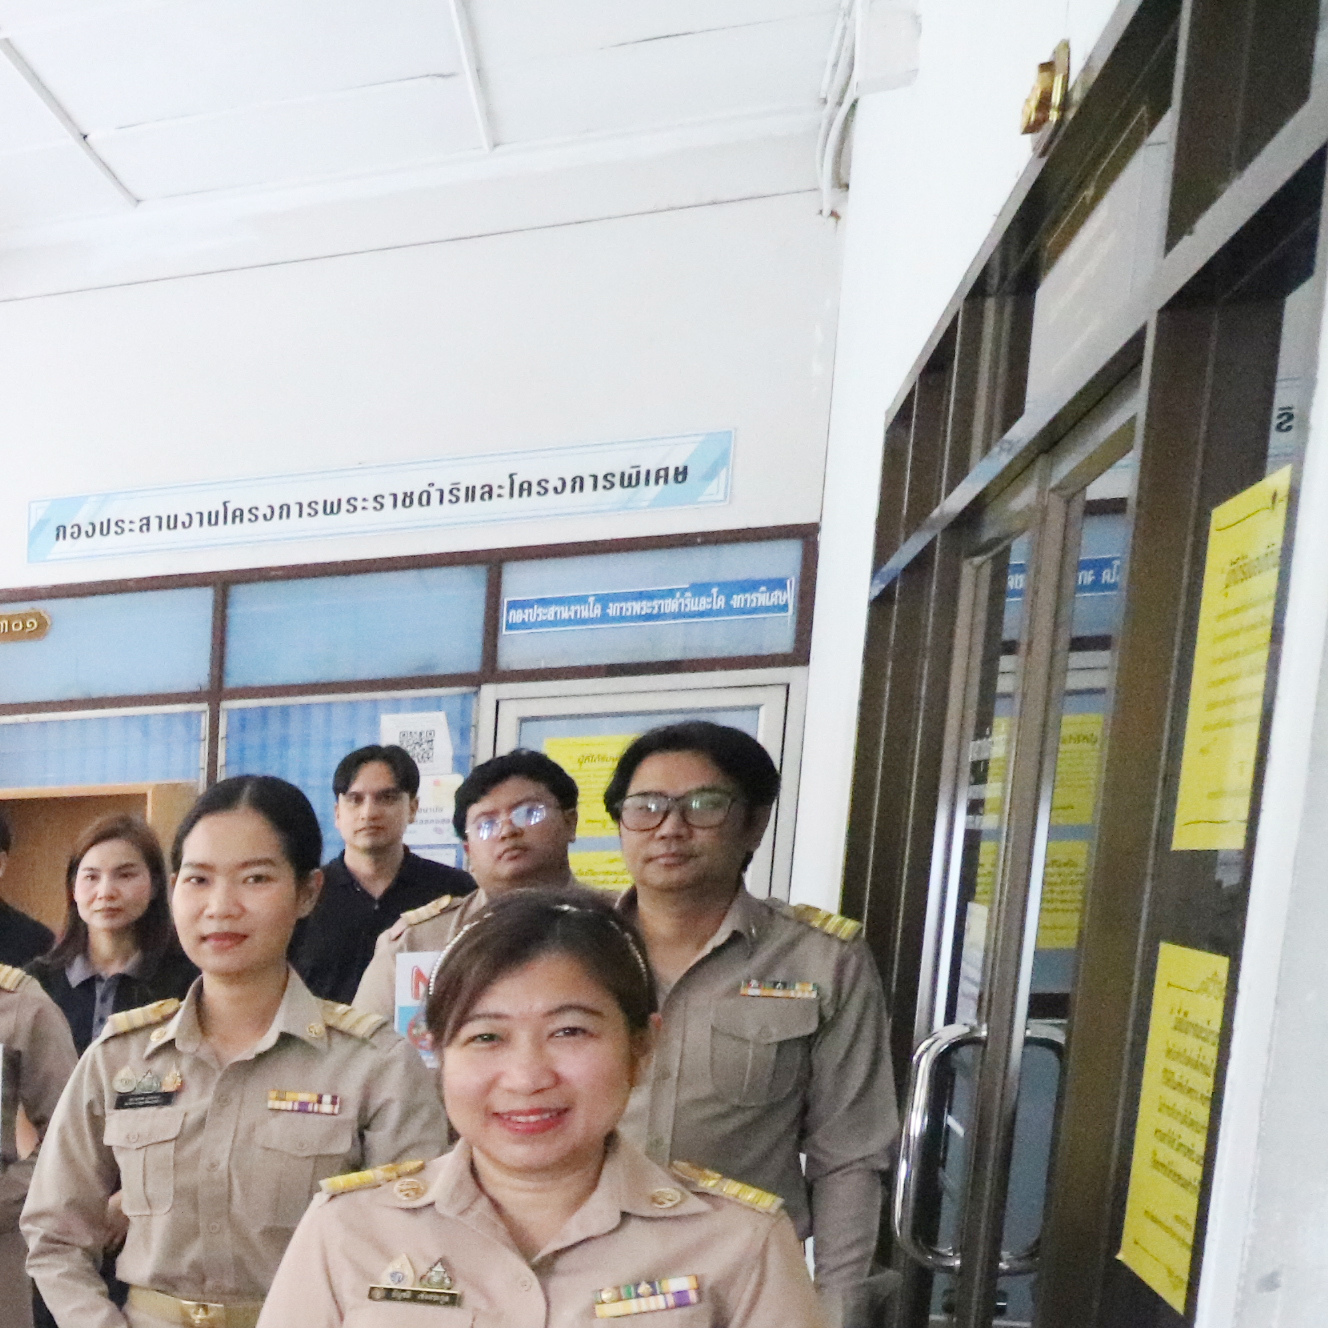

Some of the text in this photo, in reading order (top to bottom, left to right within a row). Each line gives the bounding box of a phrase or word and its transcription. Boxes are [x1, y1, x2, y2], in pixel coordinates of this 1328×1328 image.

[55, 463, 689, 542] กองประสานงานโครงการพระราชดำริและโครงการพิเศษ
